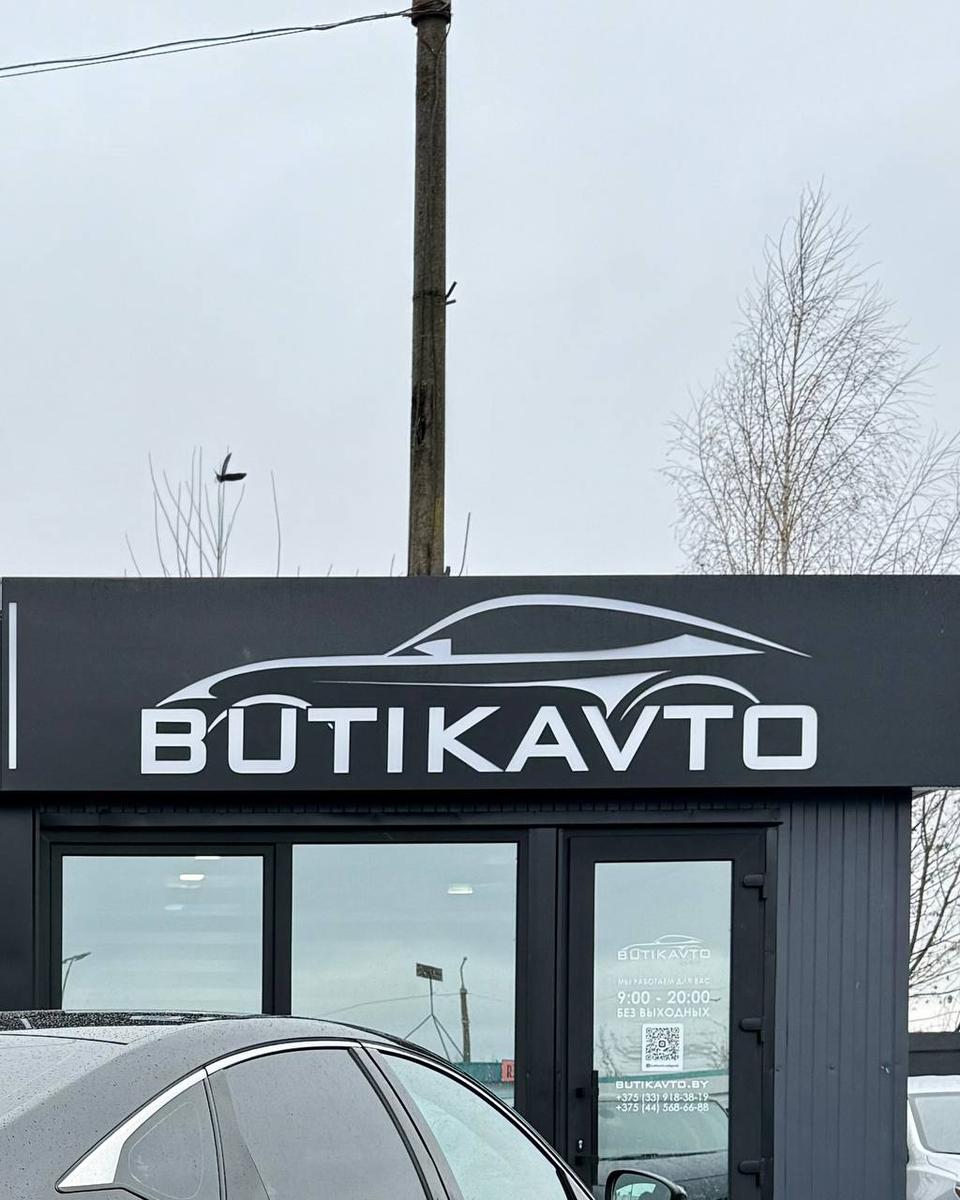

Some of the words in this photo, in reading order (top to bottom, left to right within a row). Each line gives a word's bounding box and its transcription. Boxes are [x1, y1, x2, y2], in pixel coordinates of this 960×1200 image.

[140, 704, 819, 775] BUTIKAVTO
[617, 949, 711, 960] BUTIKAVTO
[617, 991, 650, 1005] 9:00
[667, 990, 710, 1004] 20:00
[617, 1007, 636, 1018] БЕЗ
[639, 1006, 710, 1018] ВЫХОДНЫХ
[615, 1080, 709, 1089] BUTIKAVTO.BY
[615, 1093, 639, 1102] +375
[642, 1092, 660, 1104] (33)
[662, 1093, 709, 1102] 918-38-19
[615, 1103, 639, 1112] +375
[642, 1102, 660, 1114] (44)
[662, 1103, 709, 1112] 568-66-88
